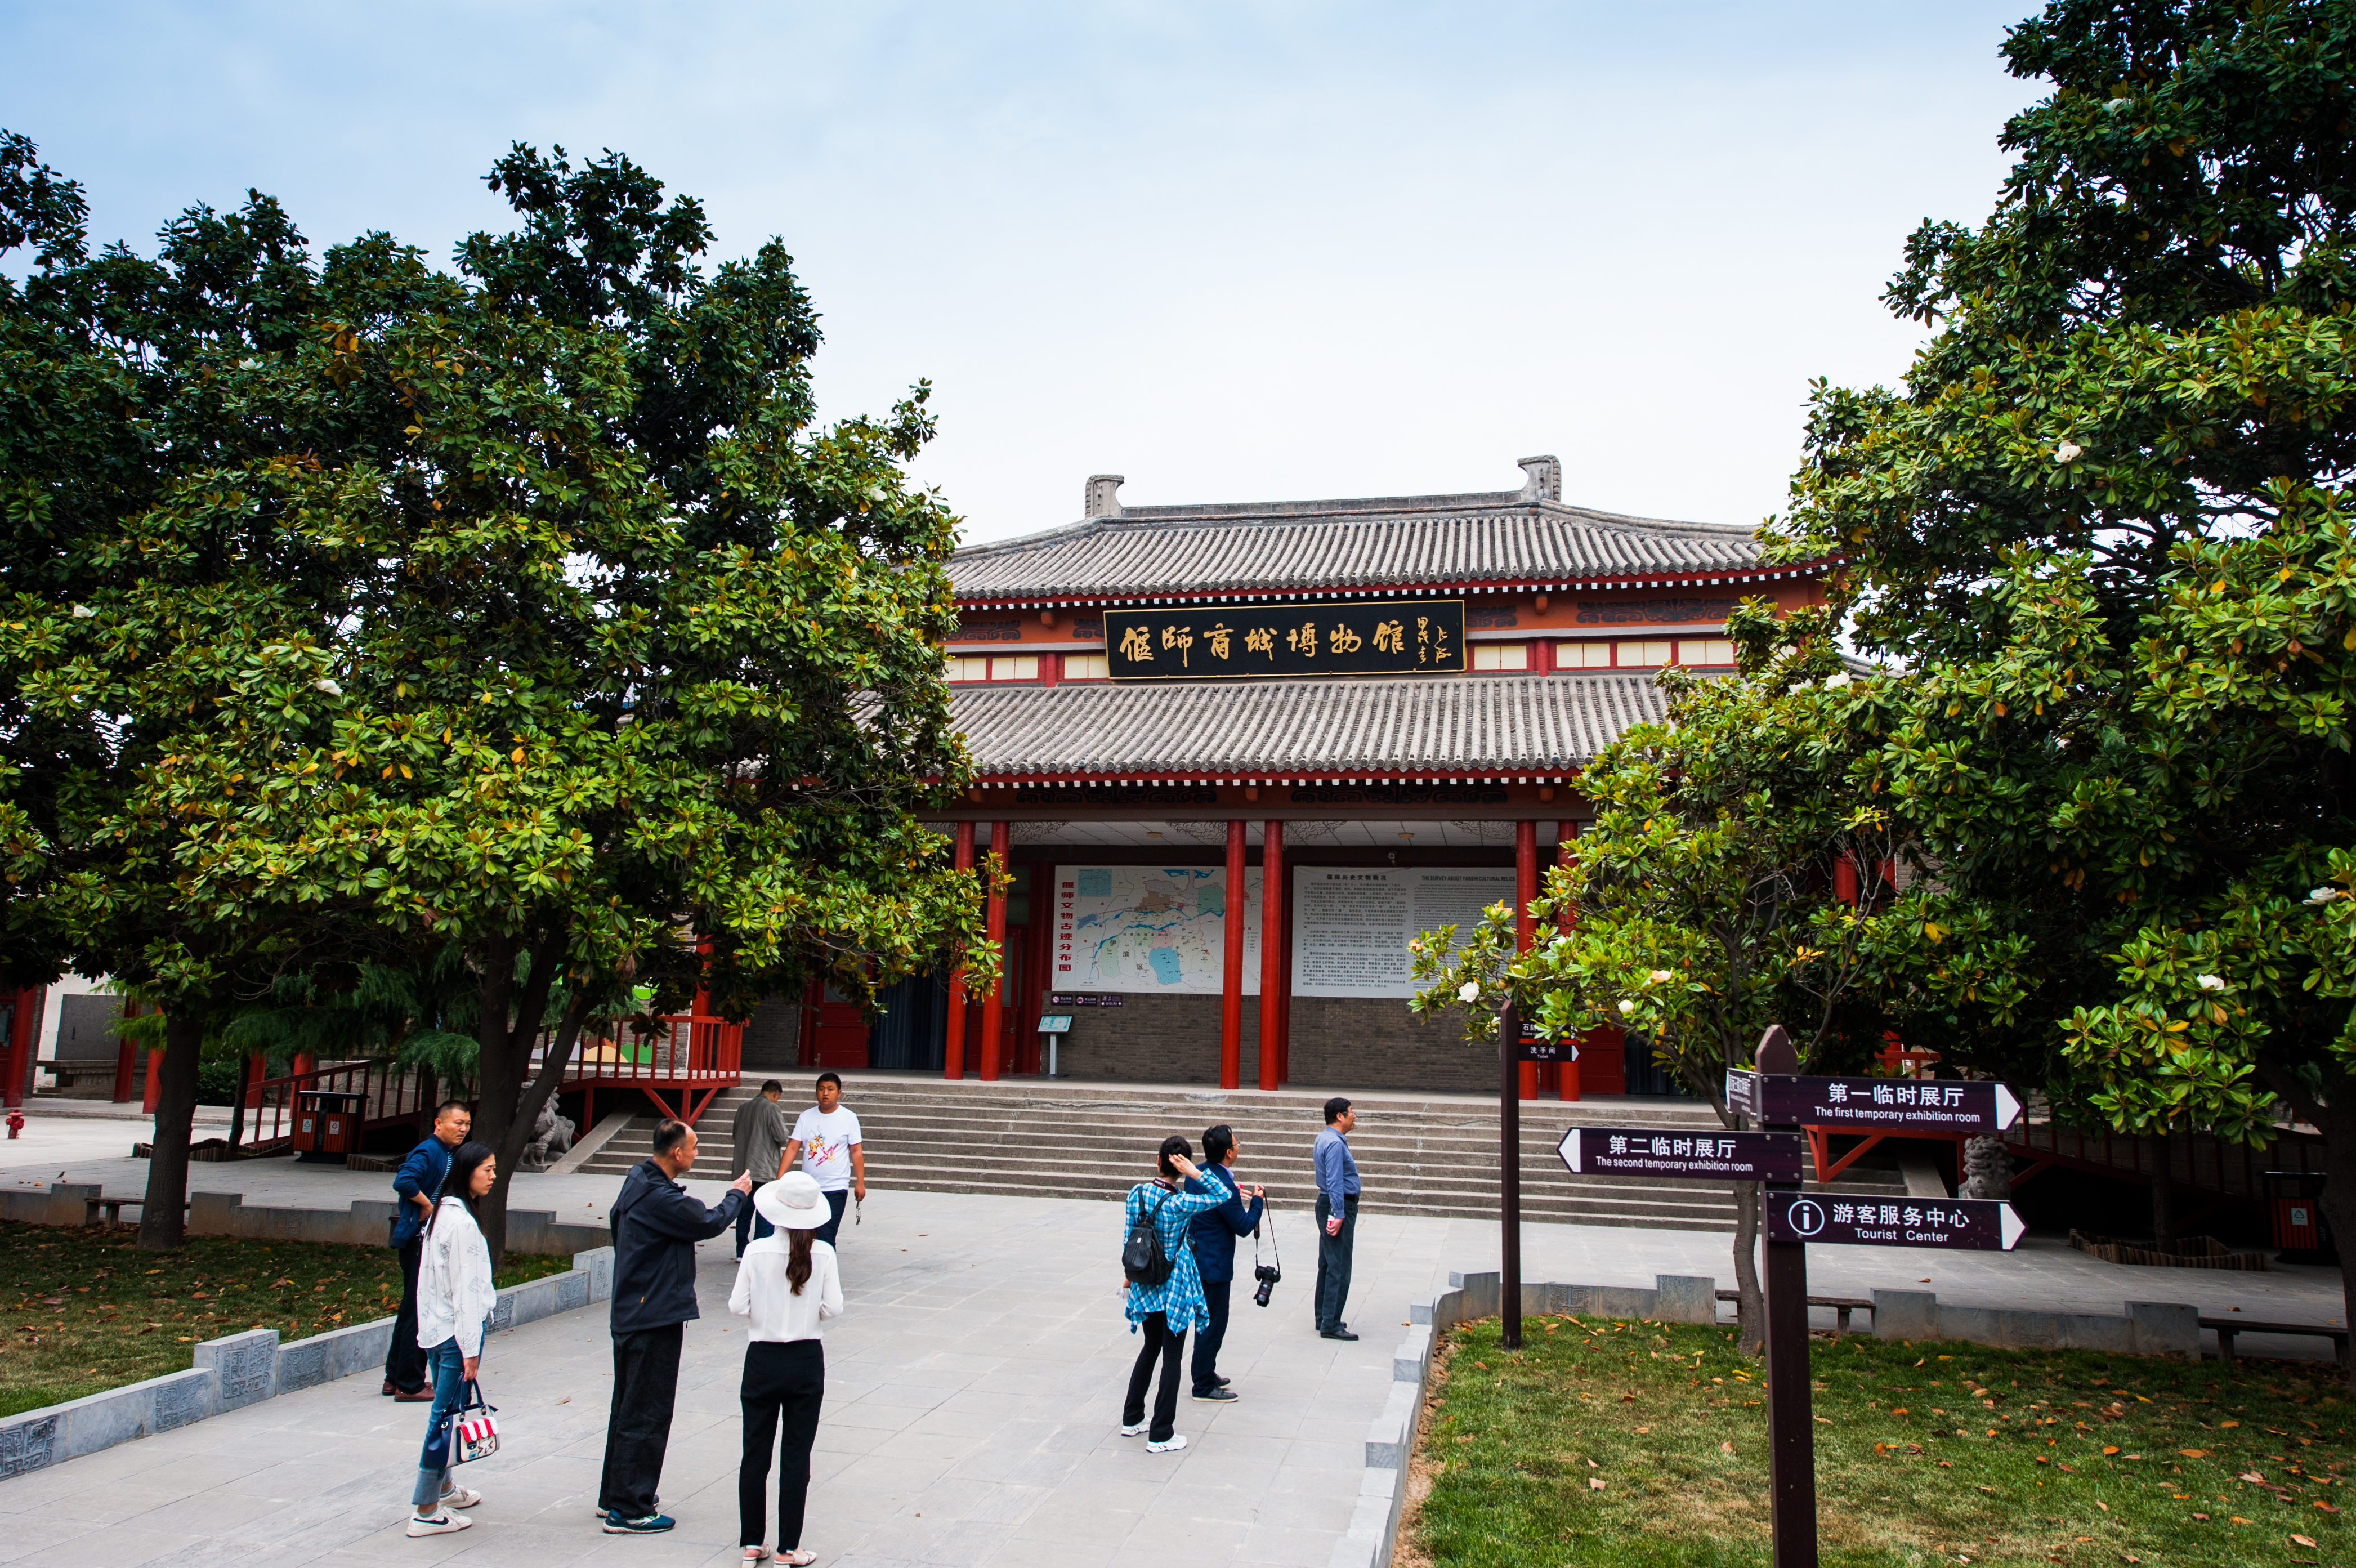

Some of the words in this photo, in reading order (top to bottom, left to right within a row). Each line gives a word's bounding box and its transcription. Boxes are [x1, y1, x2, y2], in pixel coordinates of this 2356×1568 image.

[1059, 881, 1074, 971] 偃师文物古迹分布图
[1829, 1083, 1964, 1107] 第一临时展厅
[1814, 1106, 1833, 1116] The
[1835, 1107, 1853, 1118] first
[1855, 1108, 1903, 1122] temporary
[1906, 1110, 1953, 1121] exhibition
[1955, 1113, 1981, 1122] room
[1609, 1135, 1736, 1158] 第二临时展厅
[1596, 1156, 1612, 1167] The
[1613, 1158, 1643, 1168] second
[1644, 1159, 1687, 1171] temporary
[1689, 1160, 1729, 1171] exhibition
[1731, 1163, 1753, 1172] room
[1833, 1203, 1970, 1228] 游客服务中心
[1854, 1228, 1897, 1240] Tourist
[1906, 1230, 1949, 1242] Center
